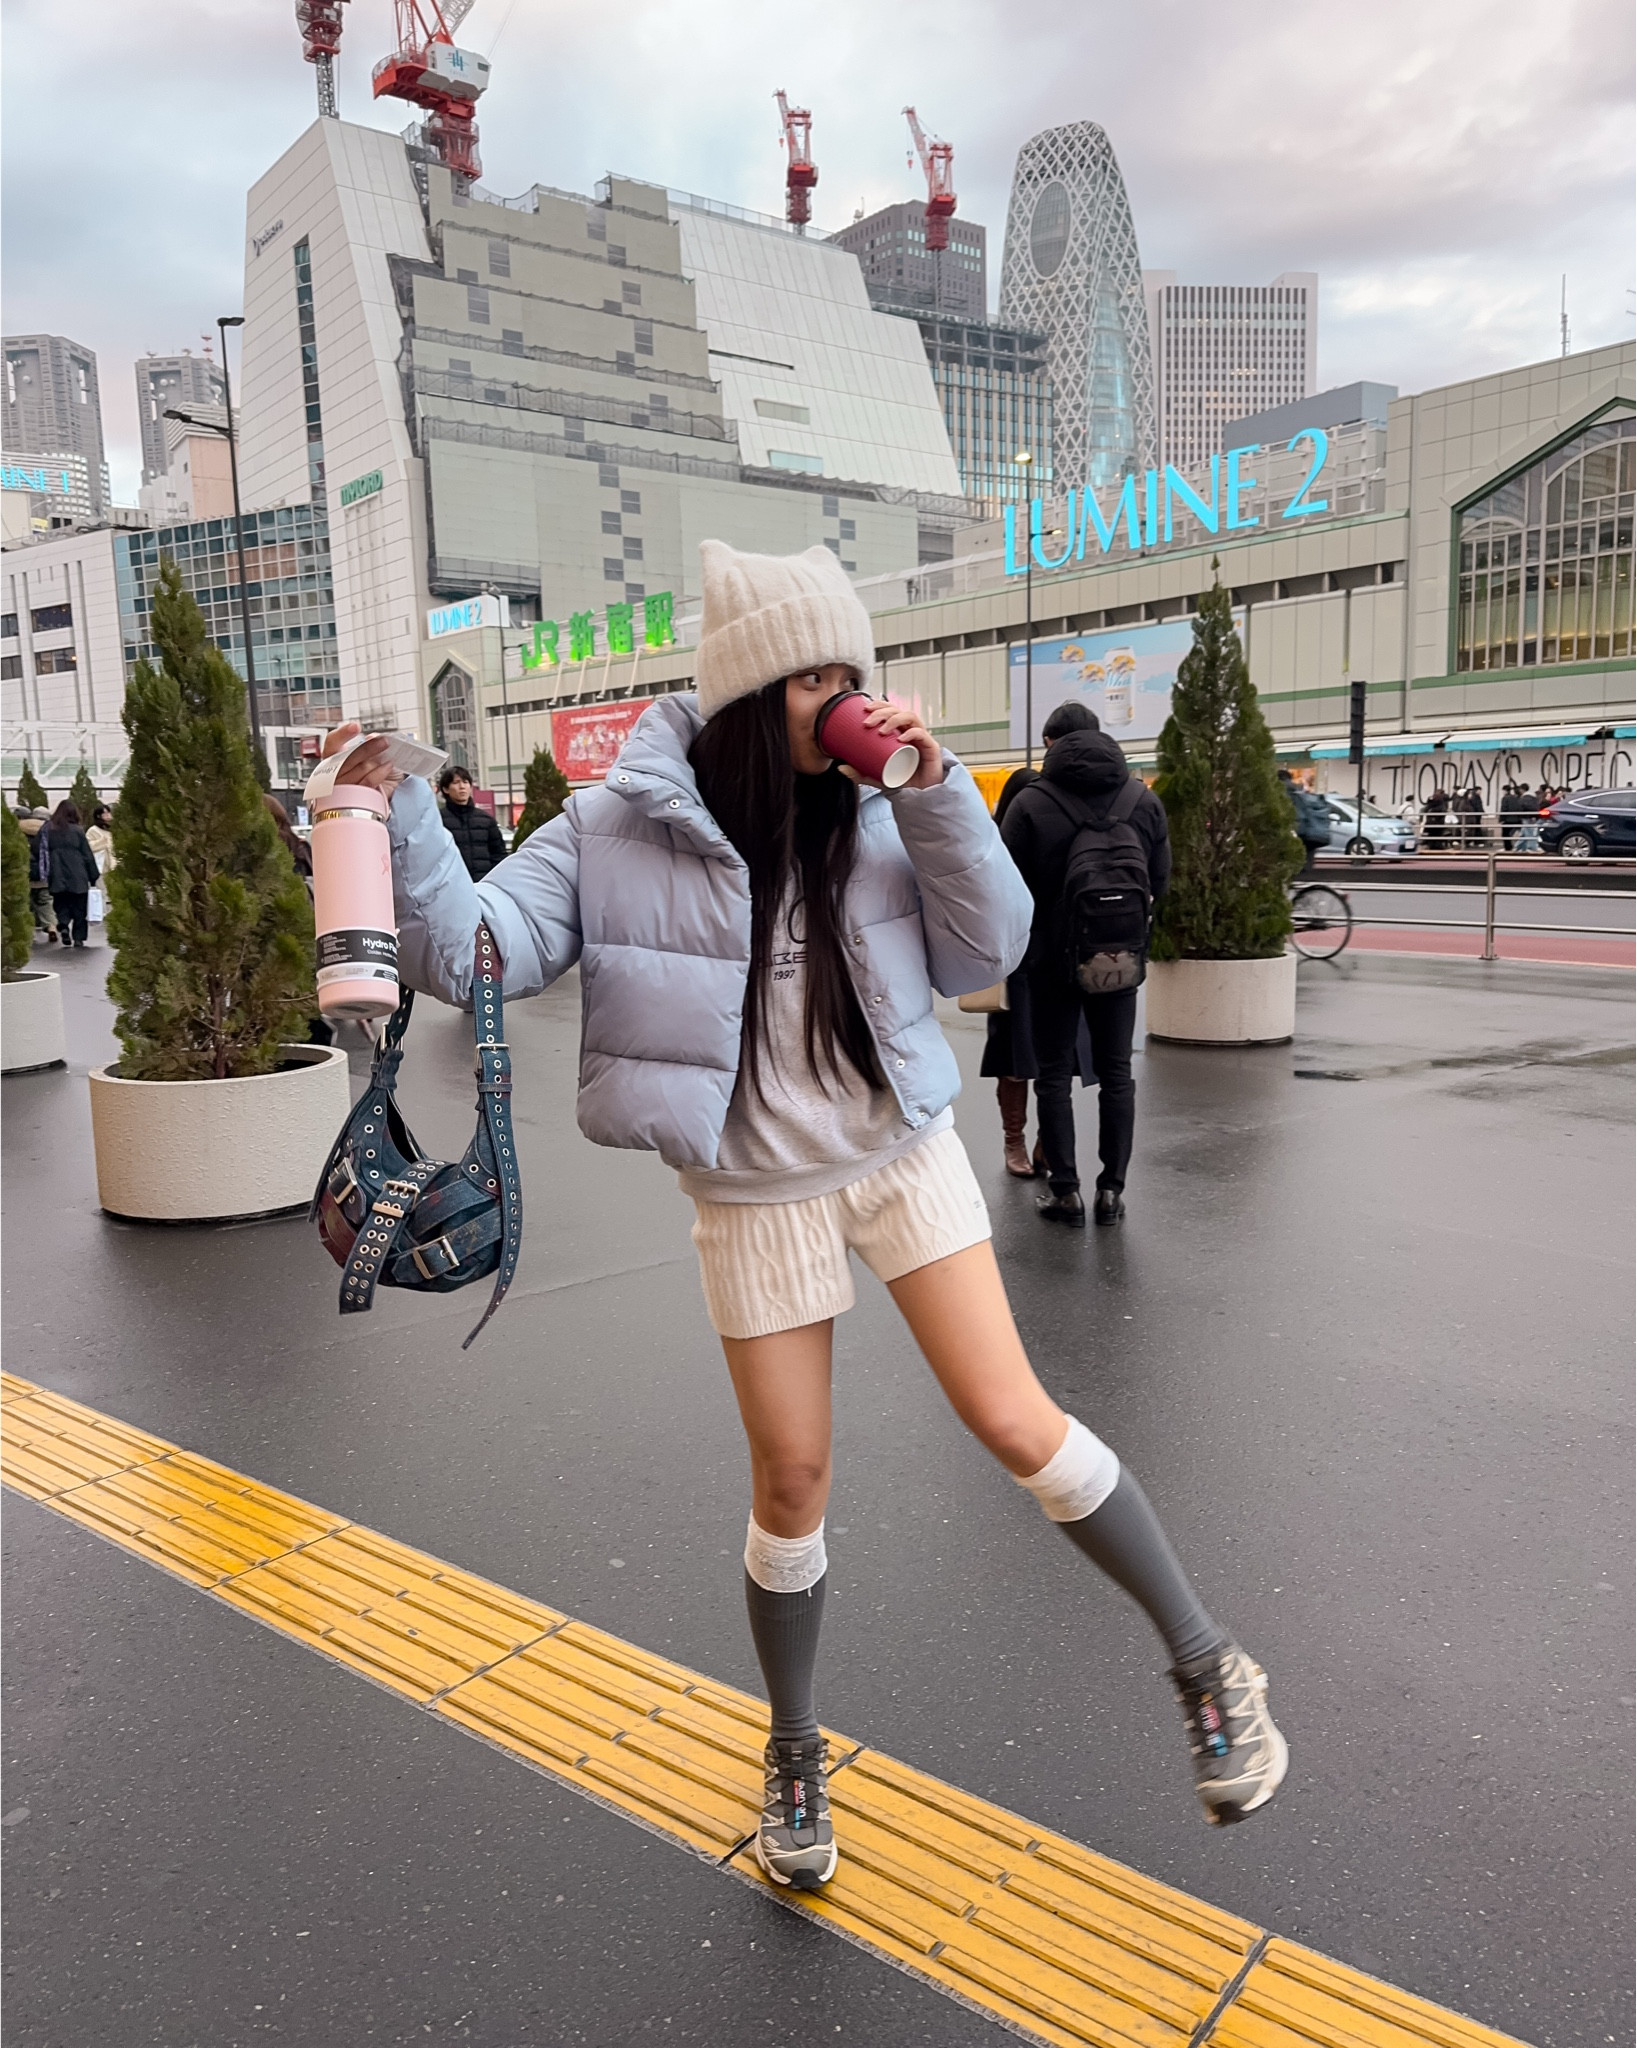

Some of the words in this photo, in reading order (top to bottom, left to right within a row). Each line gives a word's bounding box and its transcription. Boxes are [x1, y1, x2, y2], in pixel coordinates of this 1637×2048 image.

[1004, 443, 1261, 576] LUMINE
[1282, 427, 1328, 519] 2
[474, 599, 483, 625] 2
[362, 937, 389, 950] Hydro
[773, 969, 796, 981] 1997
